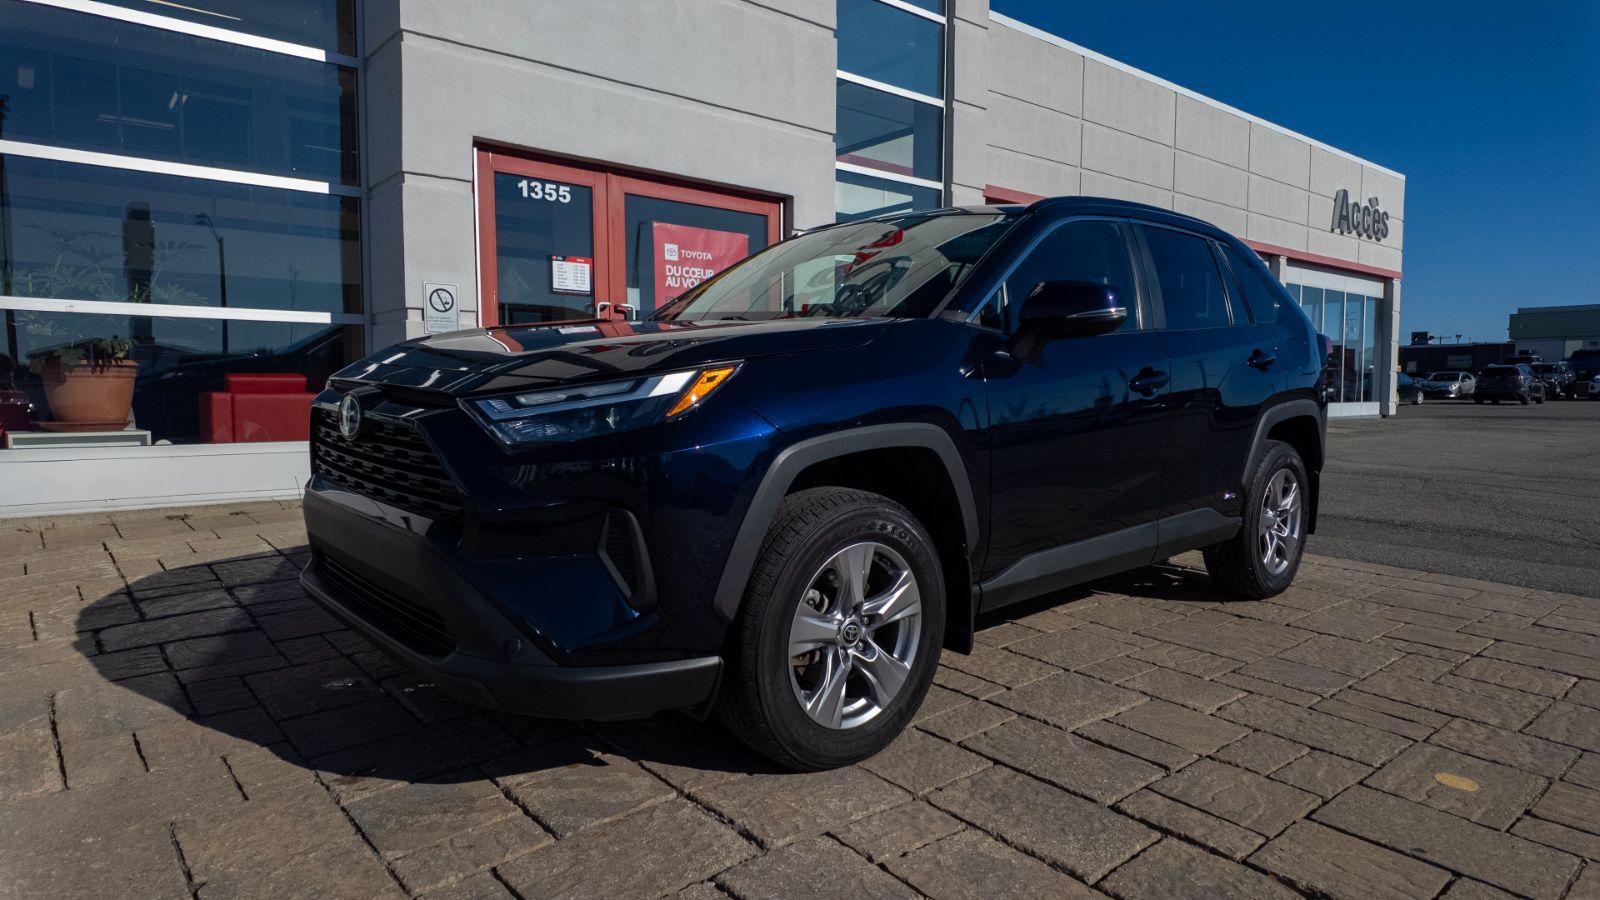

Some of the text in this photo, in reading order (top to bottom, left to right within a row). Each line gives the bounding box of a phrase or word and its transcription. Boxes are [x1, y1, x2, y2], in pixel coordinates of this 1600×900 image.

[517, 179, 571, 204] 1355
[1331, 188, 1389, 240] Accès
[681, 250, 712, 260] TOYOTA
[665, 265, 681, 276] DU
[665, 276, 681, 288] AU
